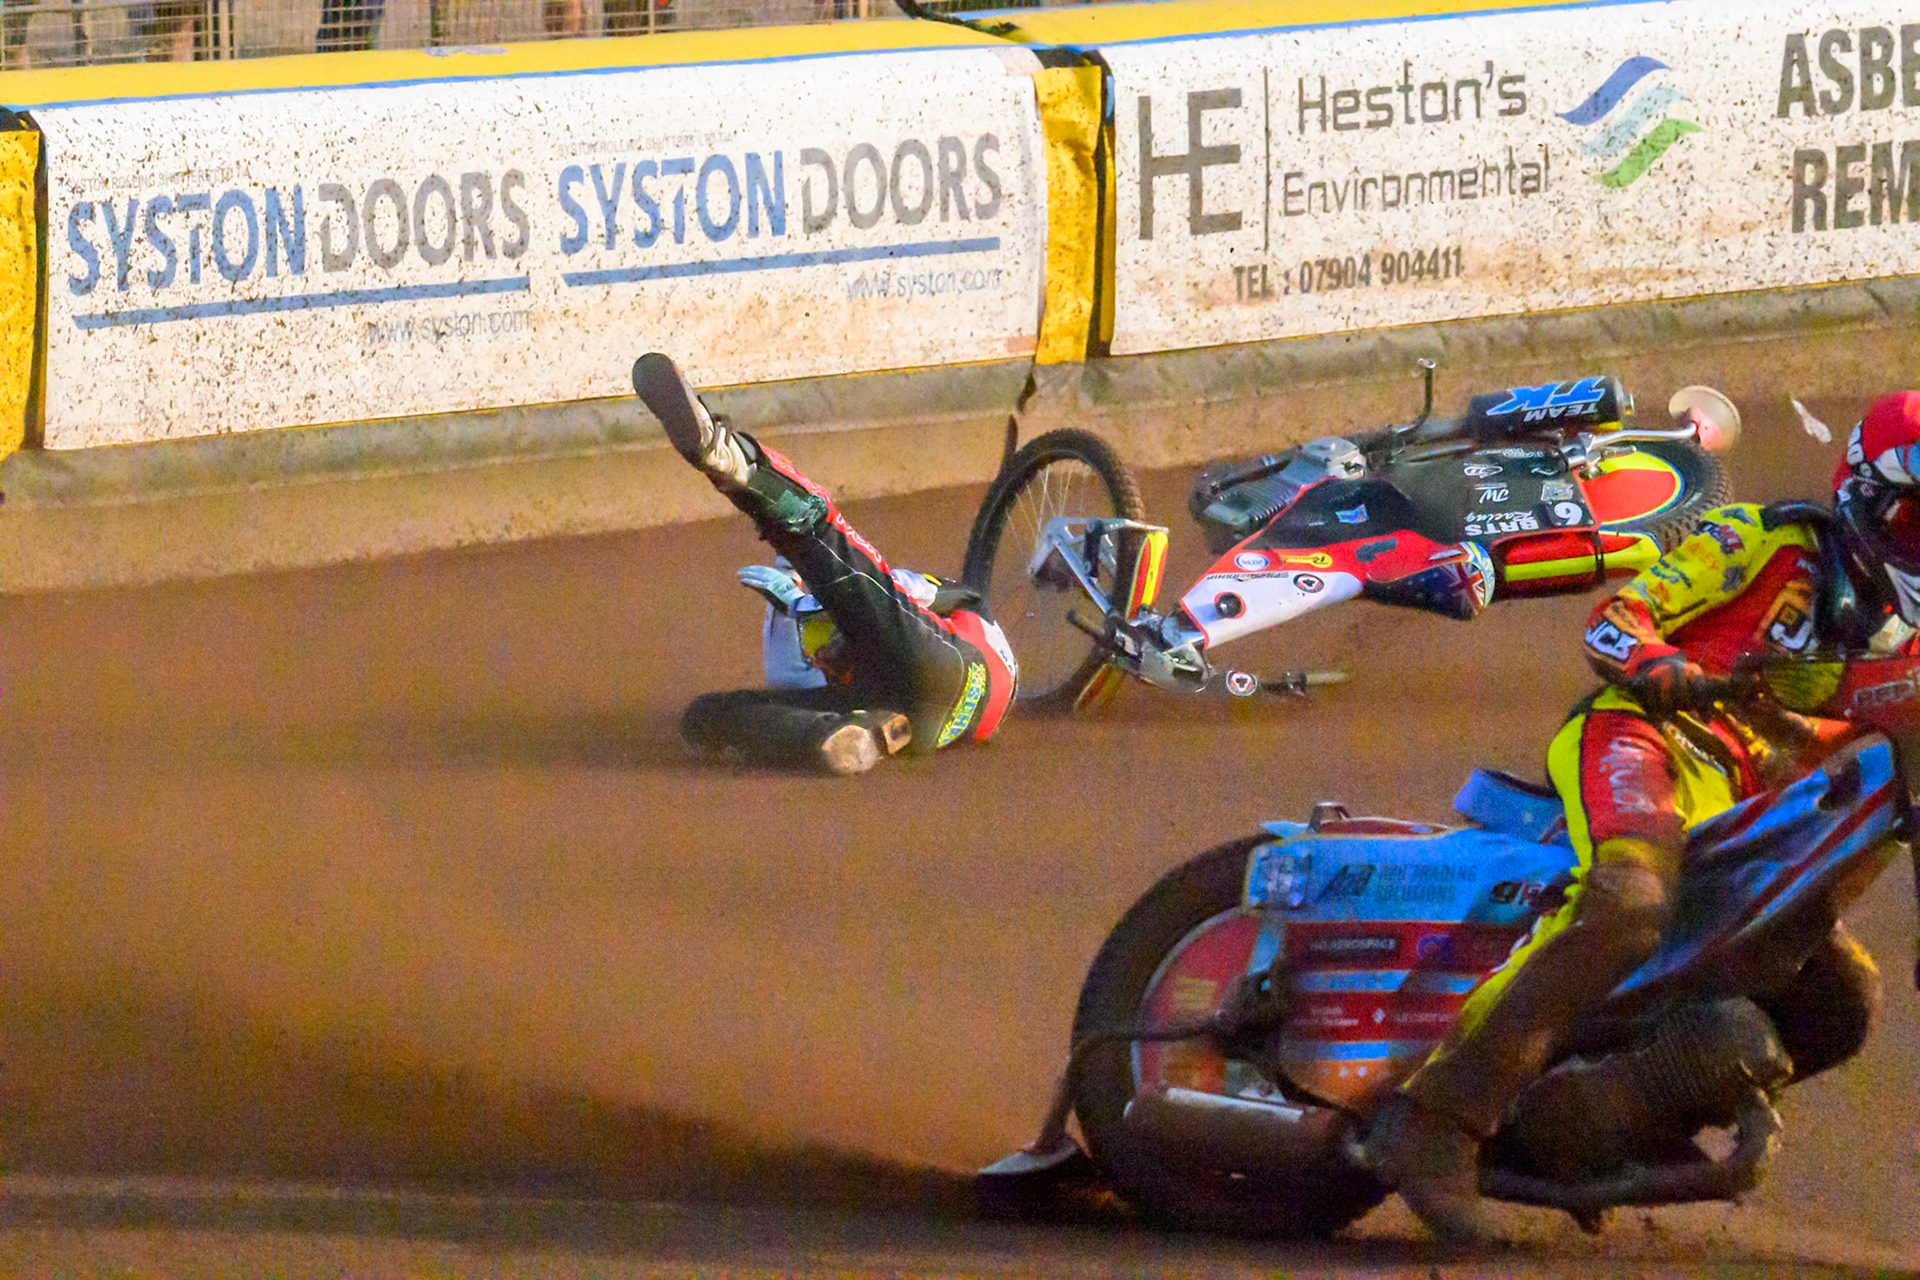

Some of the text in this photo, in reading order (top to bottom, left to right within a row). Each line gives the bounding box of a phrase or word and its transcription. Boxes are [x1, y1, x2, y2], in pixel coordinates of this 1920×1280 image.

[1298, 60, 1527, 133] Heston's
[558, 132, 1001, 255] SYSTON DOORS
[1283, 144, 1550, 217] Environmental
[68, 168, 531, 297] SYSTON DOORS
[1299, 252, 1372, 294] 07904
[1381, 246, 1462, 285] 904411
[1523, 402, 1598, 422] TEAM
[1465, 511, 1535, 523] Racing
[1554, 501, 1583, 526] 6
